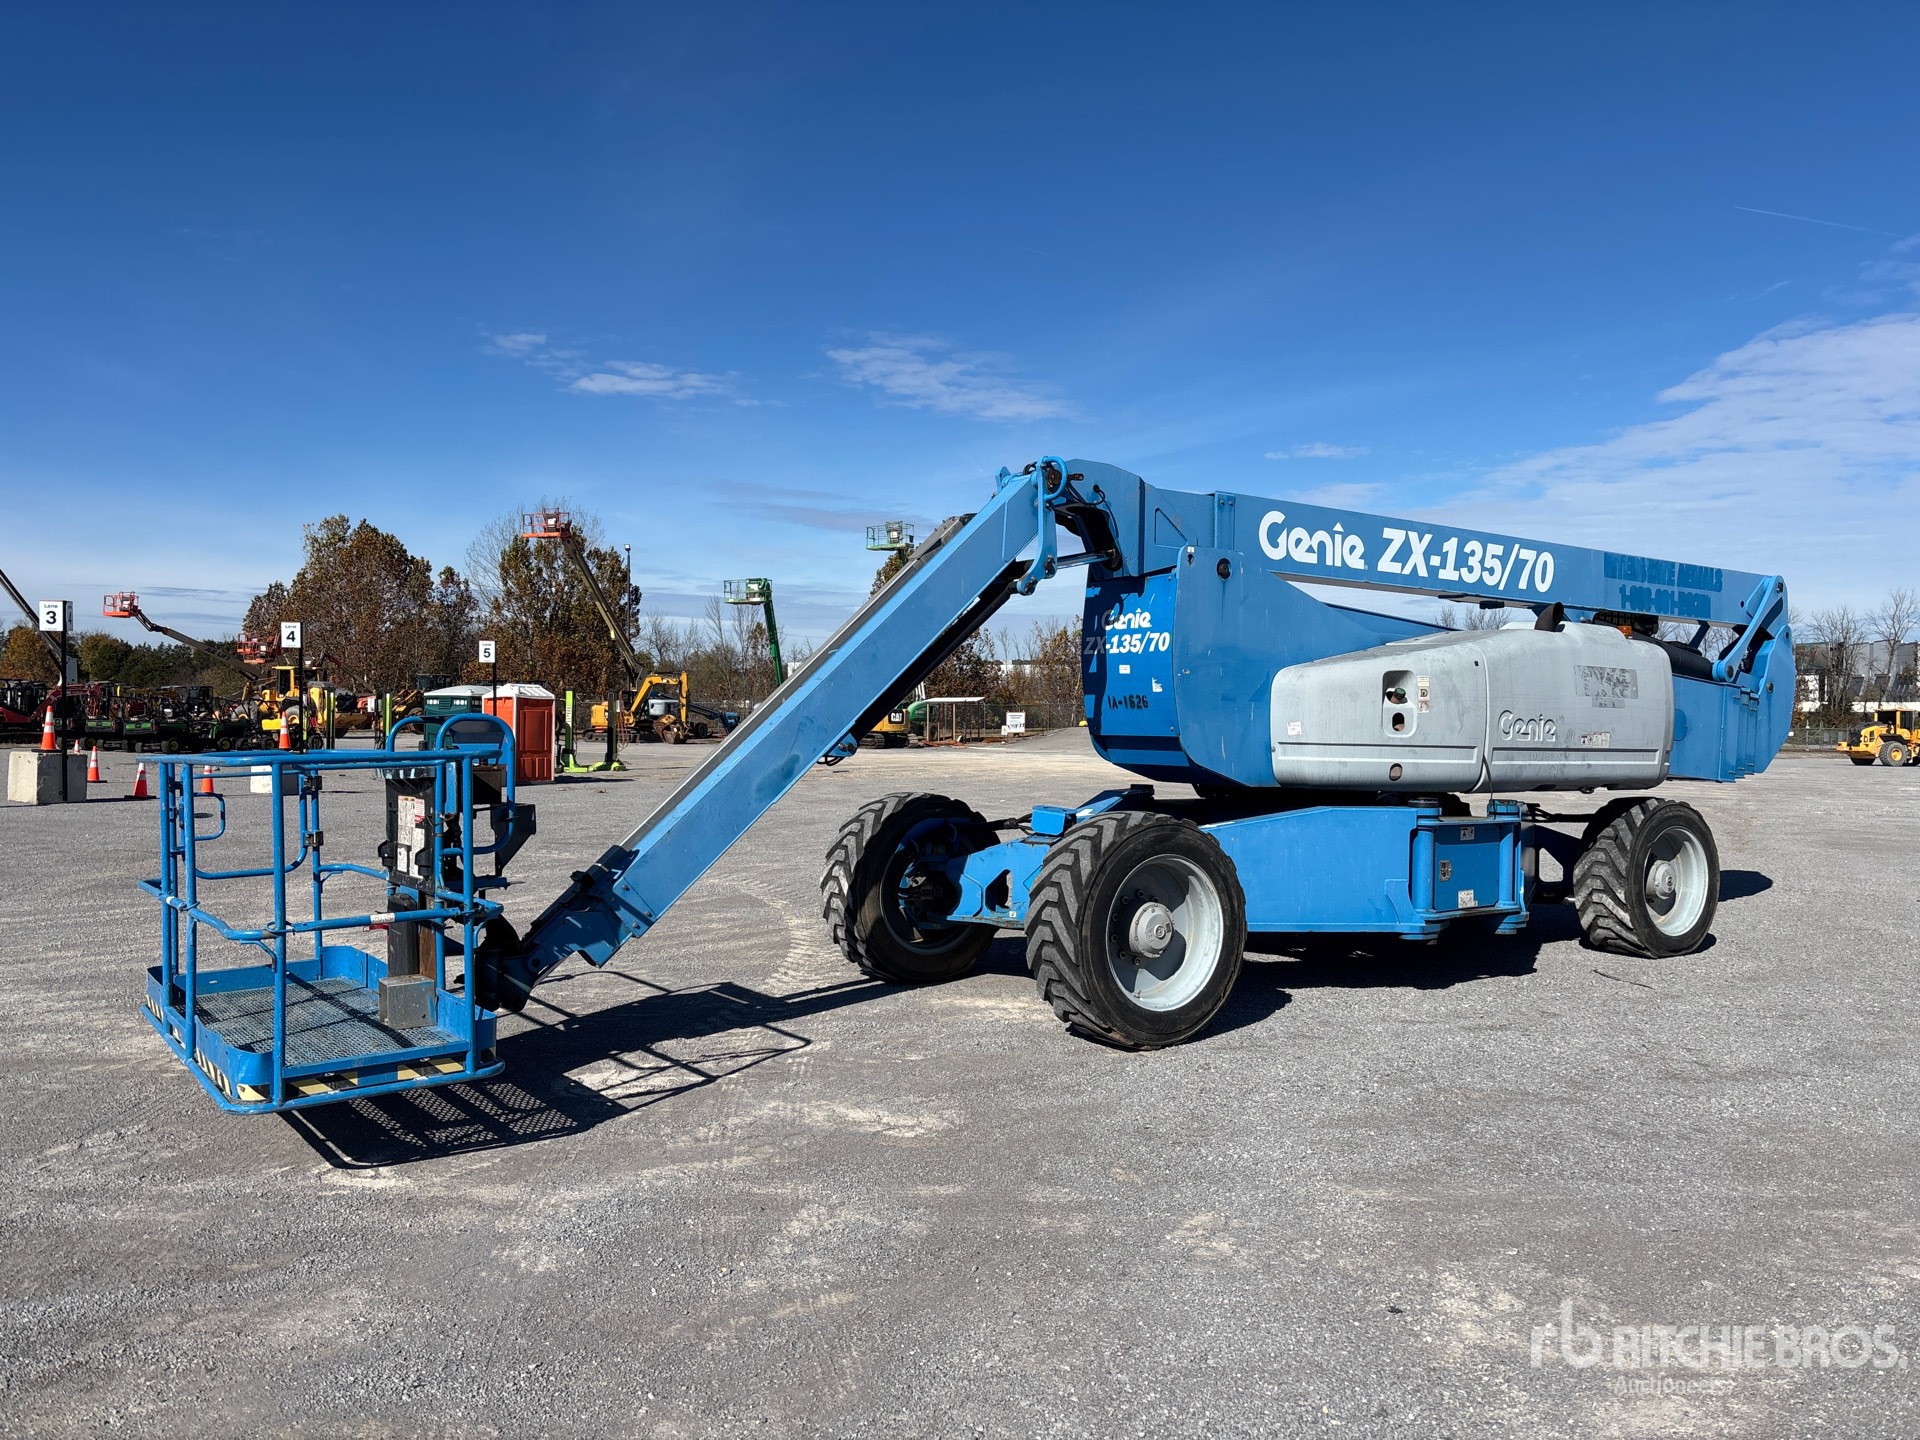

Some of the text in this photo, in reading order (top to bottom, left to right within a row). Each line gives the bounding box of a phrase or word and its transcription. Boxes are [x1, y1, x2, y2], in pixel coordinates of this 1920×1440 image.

[1258, 510, 1366, 570] Genie
[1377, 527, 1555, 593] ZX-135/70
[45, 610, 57, 625] 3
[1101, 607, 1153, 631] Genie
[286, 630, 296, 643] 4
[1083, 631, 1171, 655] ZX-135/70
[483, 647, 491, 658] 5
[890, 712, 903, 722] CAT
[1498, 709, 1557, 742] Genie
